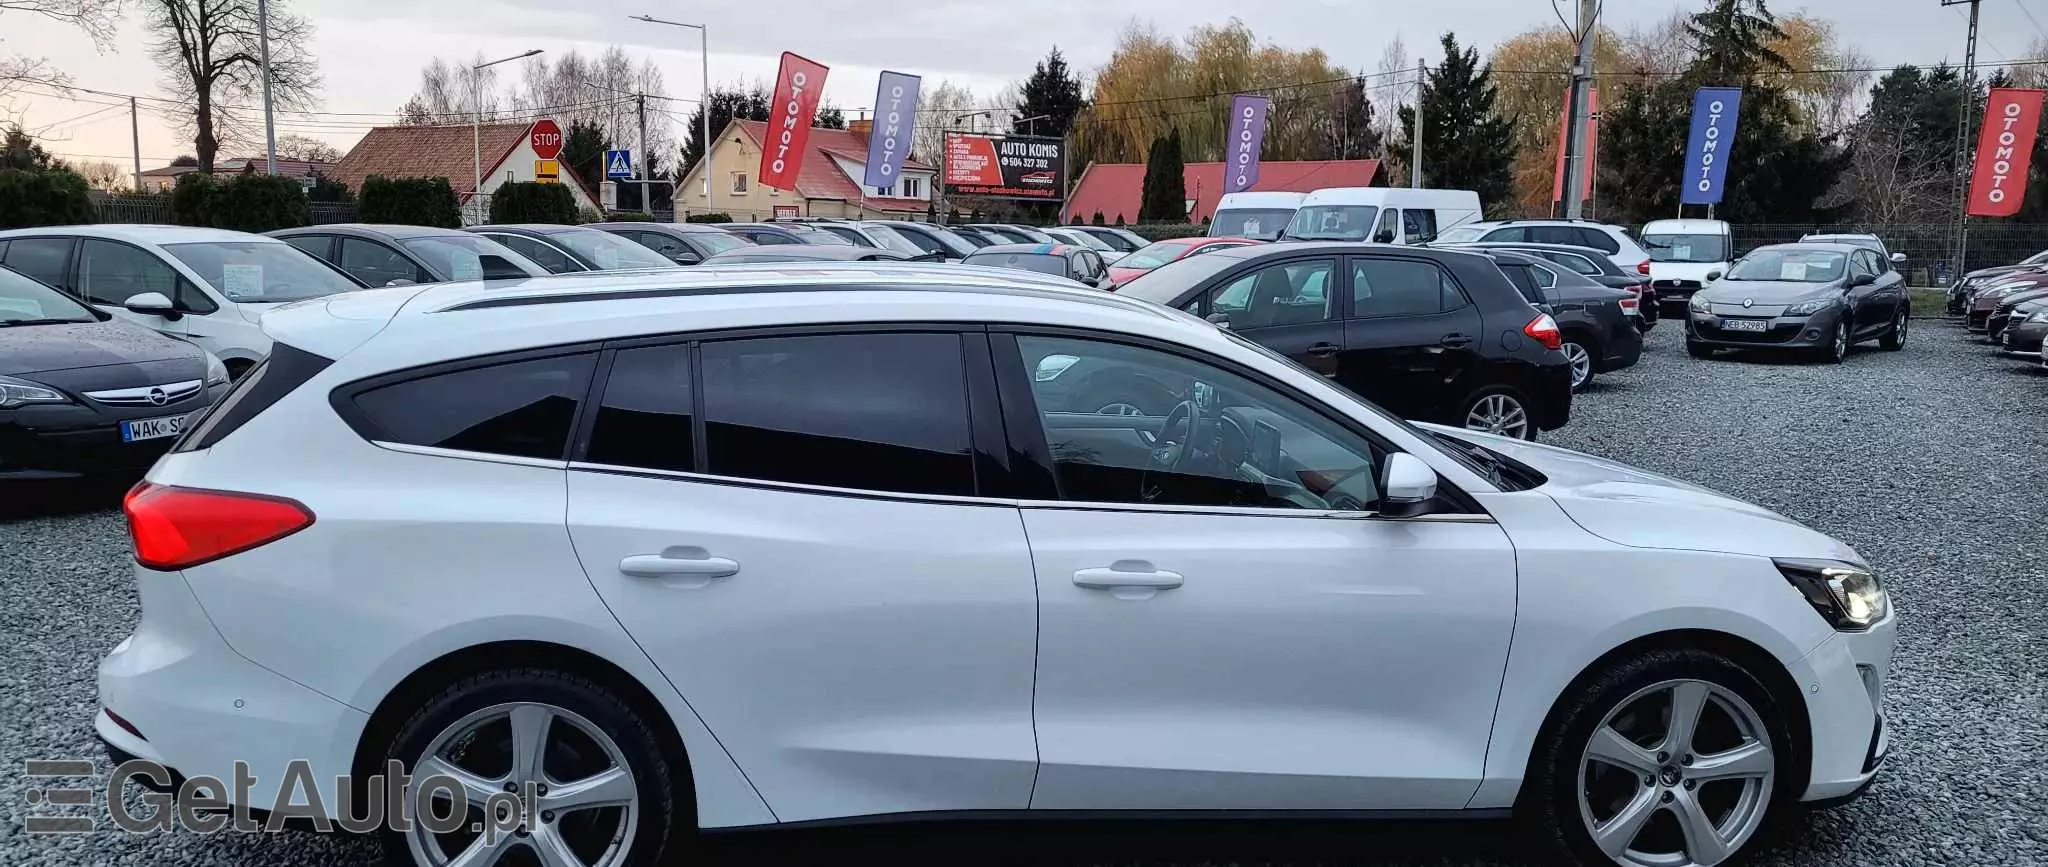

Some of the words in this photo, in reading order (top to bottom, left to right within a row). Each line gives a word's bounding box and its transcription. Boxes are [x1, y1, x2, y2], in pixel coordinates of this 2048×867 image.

[533, 133, 560, 146] STOP
[772, 72, 807, 174] OTOMOTO
[880, 86, 904, 176] OTOMOTO
[1001, 141, 1026, 156] AUTO
[1028, 143, 1058, 158] KOMIS
[1237, 107, 1254, 185] OTOMOTO
[1699, 101, 1723, 191] OTOMOTO
[1989, 103, 2020, 202] OTOMOTO
[1009, 157, 1022, 167] 504
[1023, 158, 1035, 168] 327
[1036, 159, 1048, 169] 302
[131, 420, 160, 438] WAK
